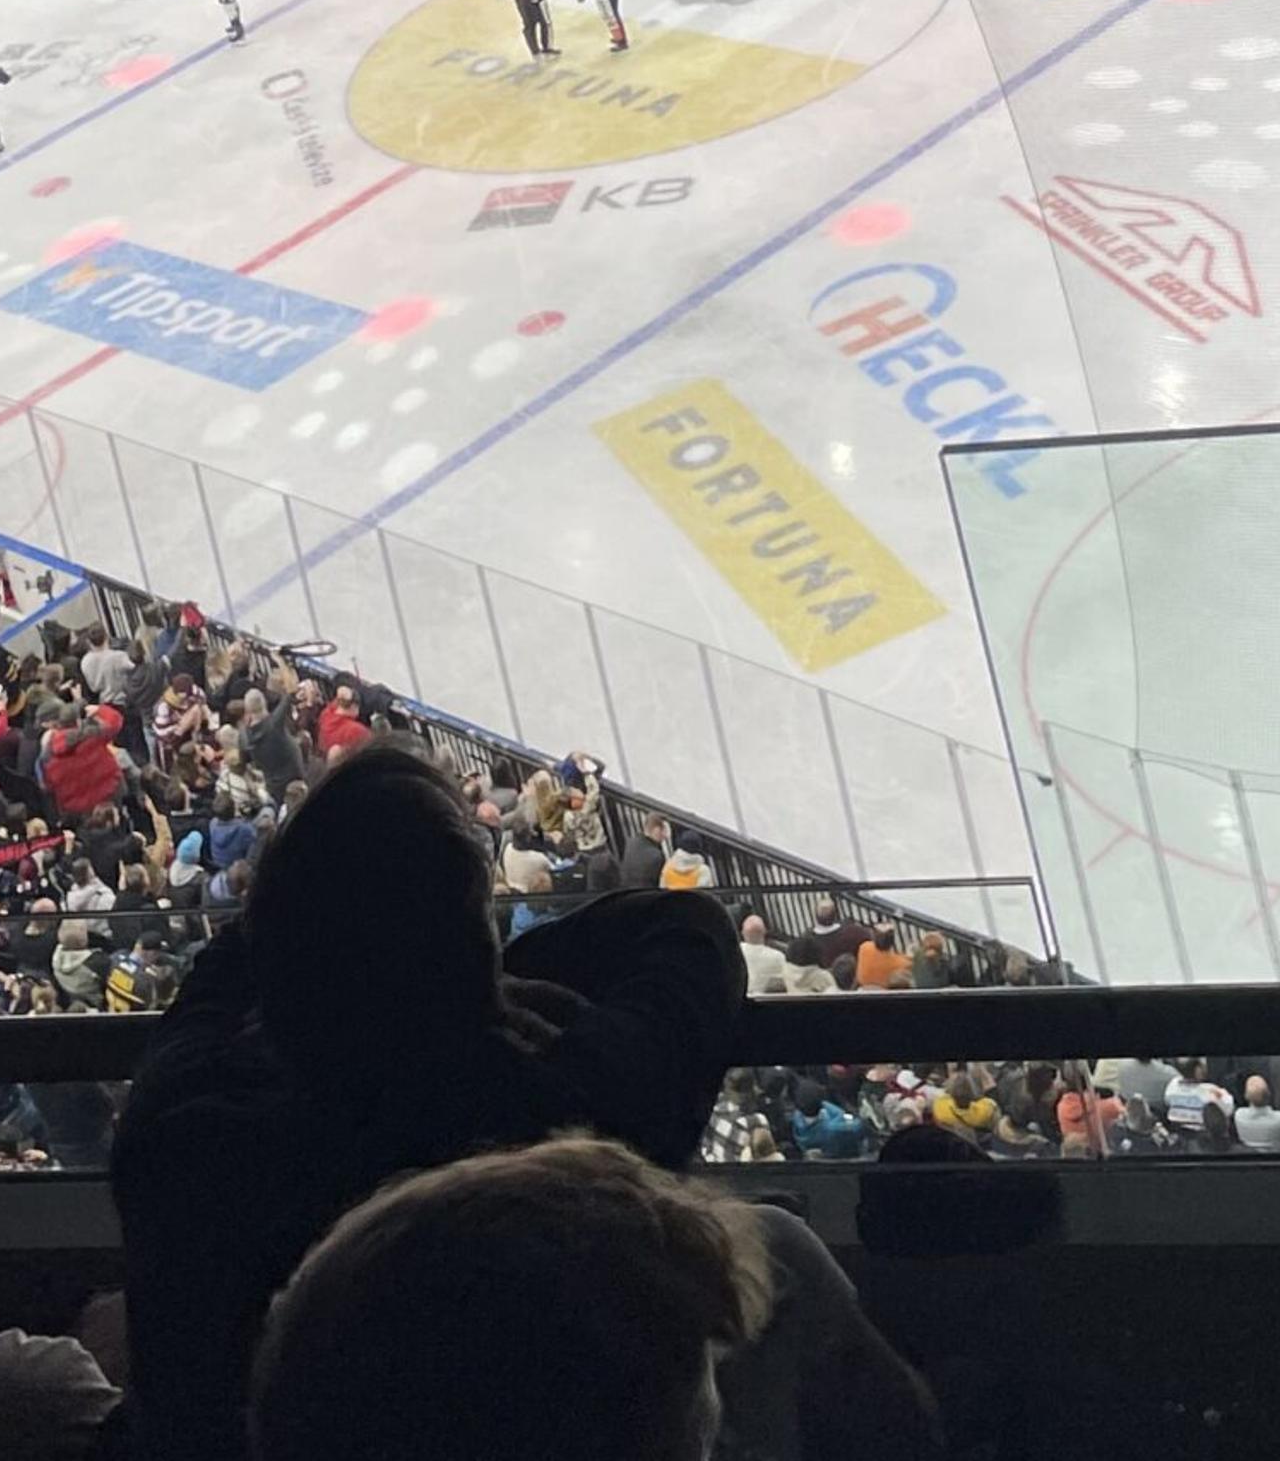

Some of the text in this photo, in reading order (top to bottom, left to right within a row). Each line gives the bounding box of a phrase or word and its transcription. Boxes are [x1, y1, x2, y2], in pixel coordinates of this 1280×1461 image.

[582, 177, 695, 214] KB
[92, 273, 317, 359] Tipsport
[639, 406, 880, 636] FORTUNA
